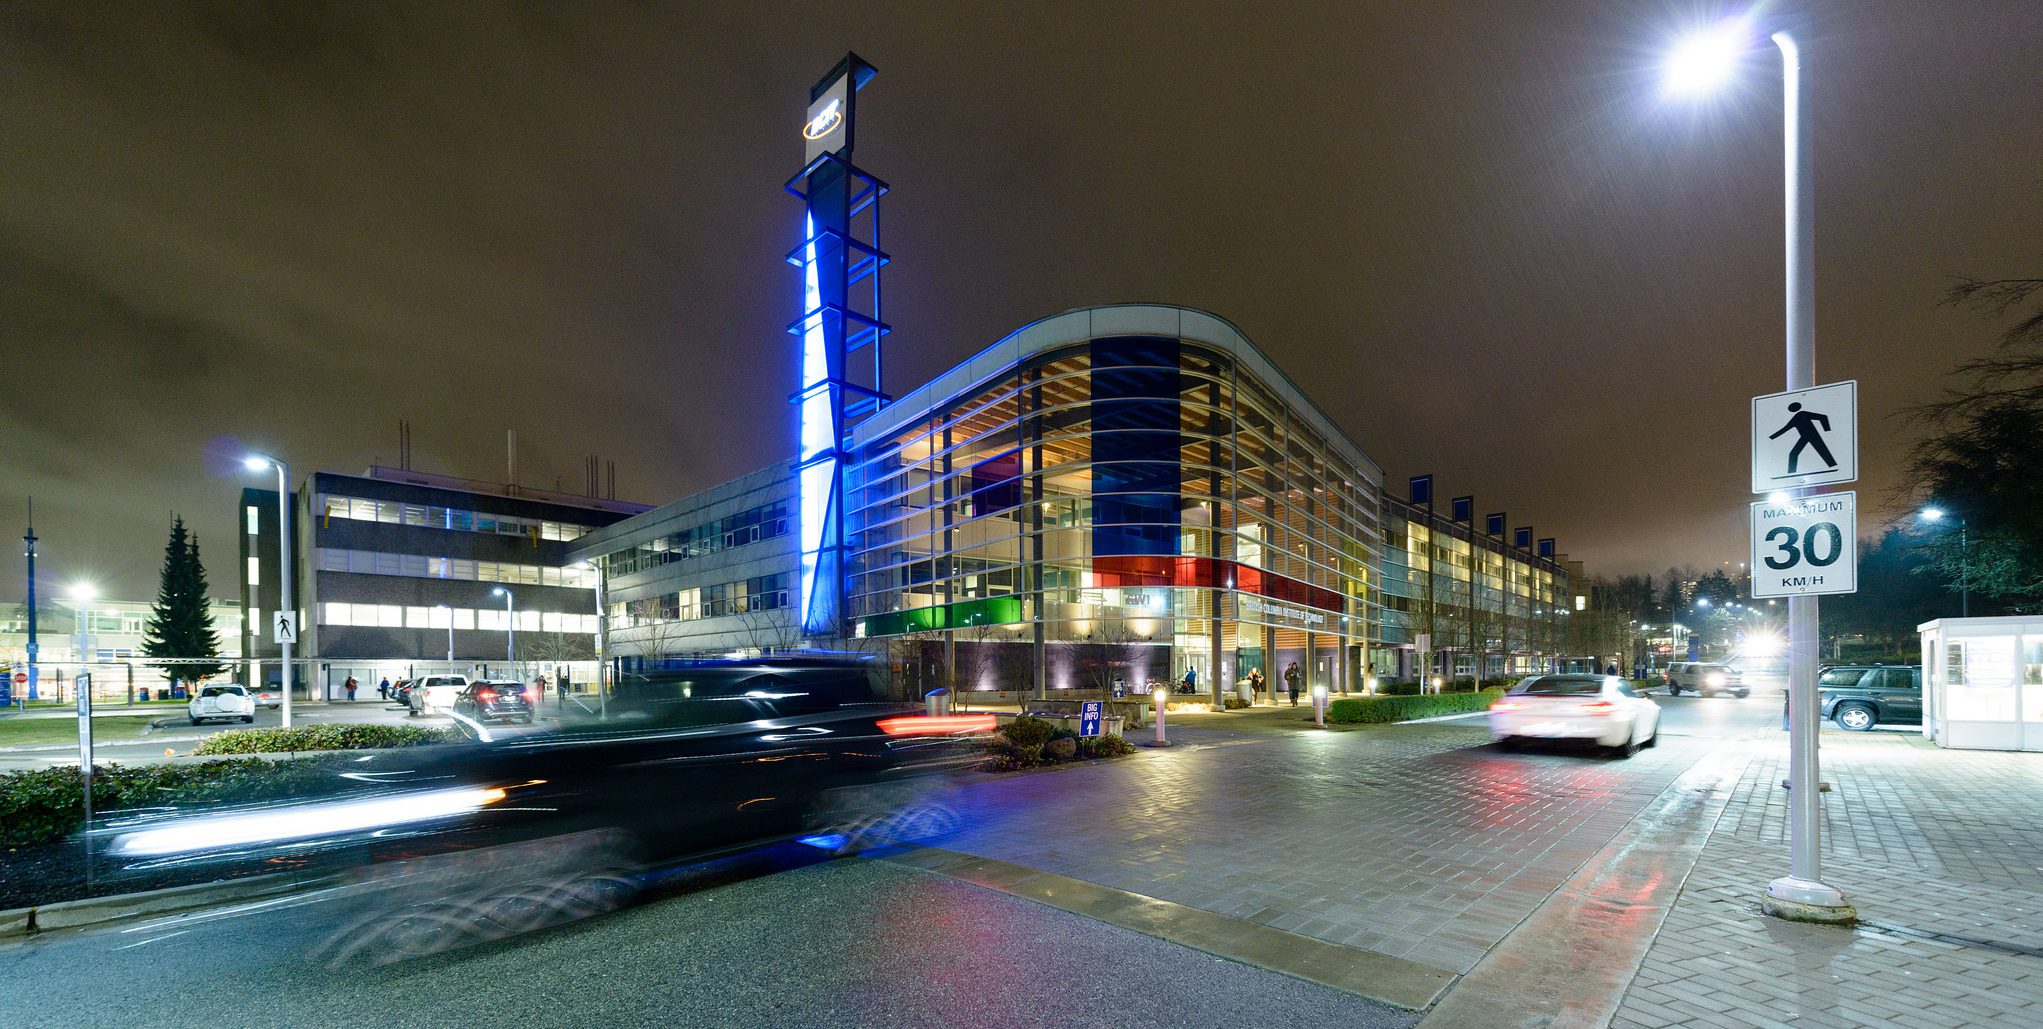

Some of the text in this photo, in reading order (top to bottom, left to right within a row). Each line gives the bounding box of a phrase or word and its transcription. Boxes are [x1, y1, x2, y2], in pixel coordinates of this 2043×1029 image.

[1763, 501, 1843, 519] MAMUM
[1764, 522, 1842, 570] 30
[1782, 576, 1824, 587] KM/H
[1087, 703, 1098, 711] BIG
[1084, 712, 1099, 720] INFO
